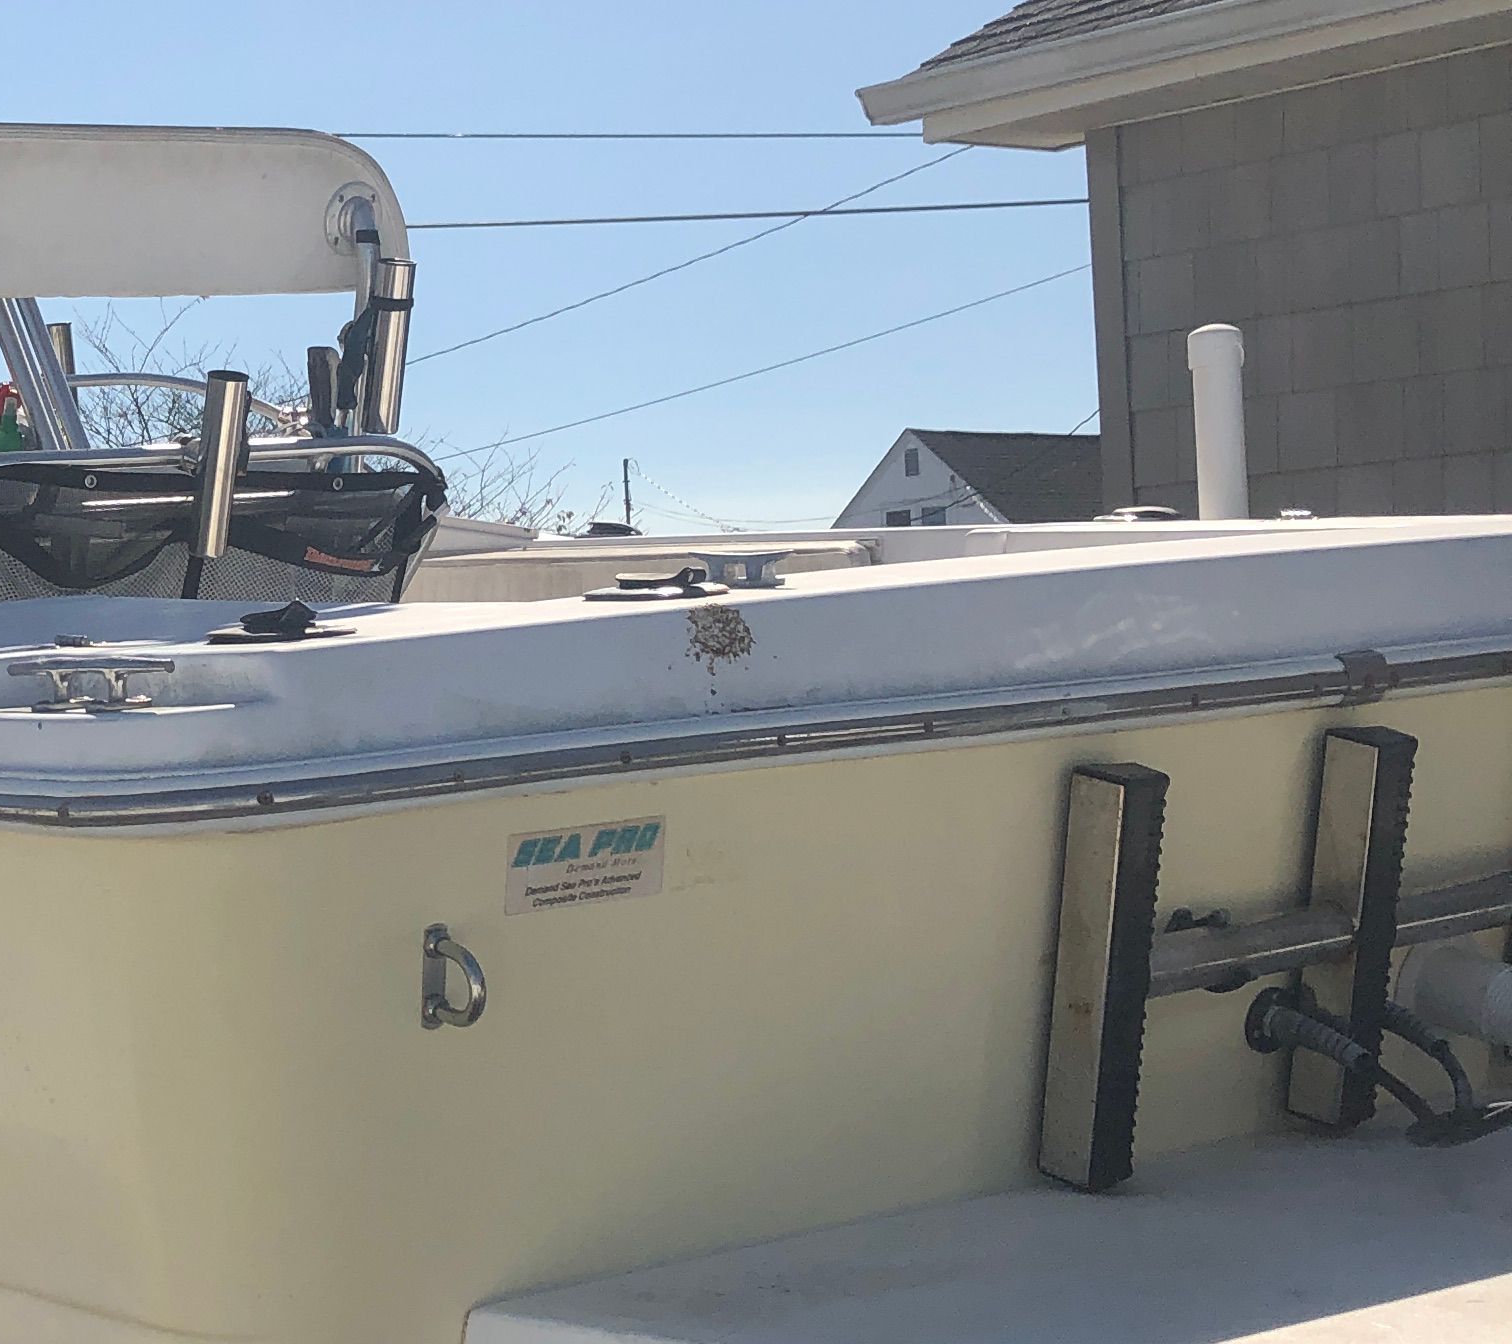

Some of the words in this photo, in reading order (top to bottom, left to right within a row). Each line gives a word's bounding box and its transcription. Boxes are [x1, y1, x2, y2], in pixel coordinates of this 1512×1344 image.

[511, 833, 582, 868] SEA
[588, 822, 662, 858] PRO
[525, 881, 559, 897] Demand
[600, 871, 642, 886] Advanced
[578, 886, 632, 901] Construction
